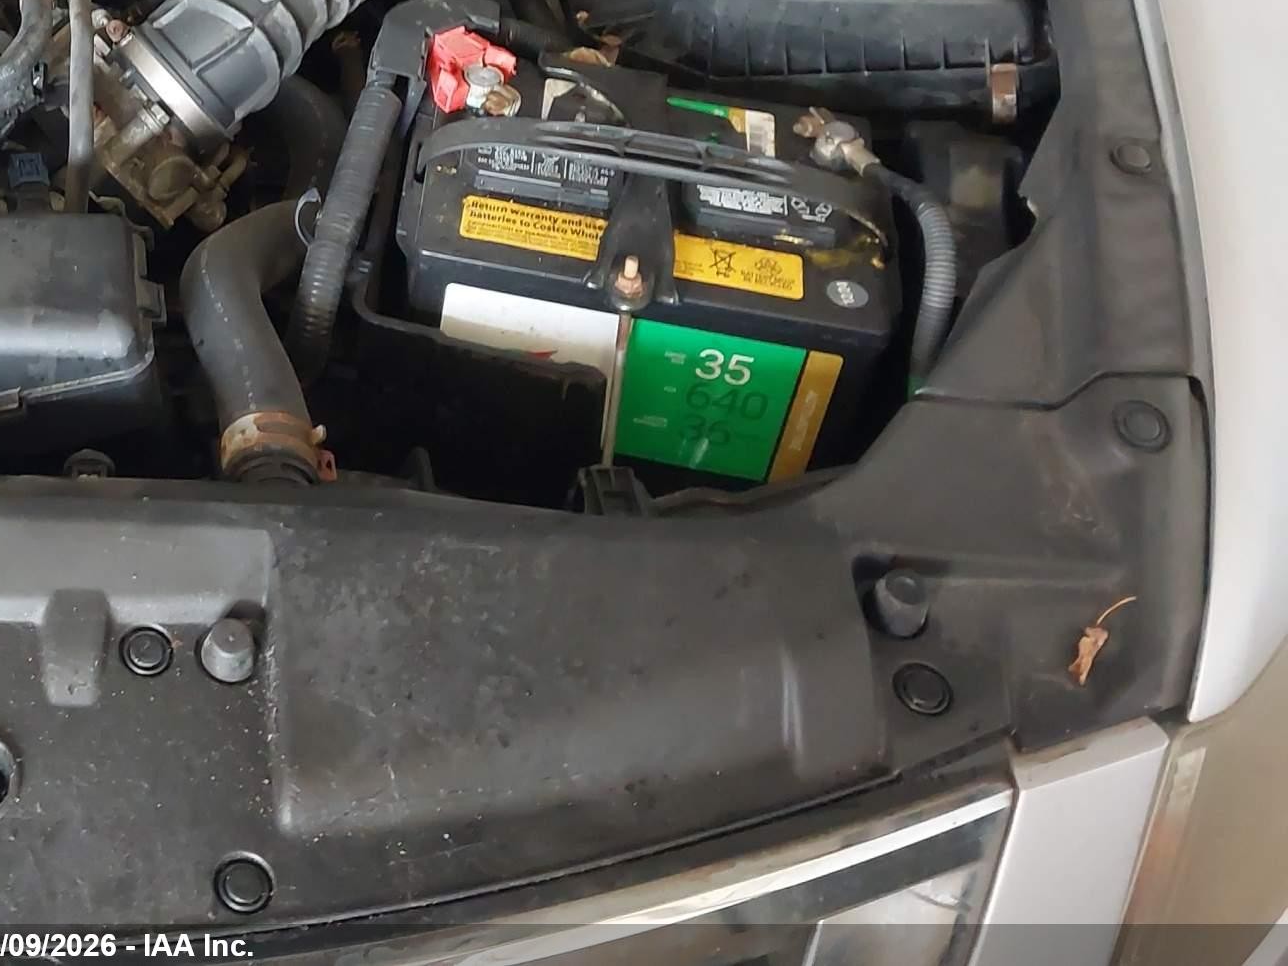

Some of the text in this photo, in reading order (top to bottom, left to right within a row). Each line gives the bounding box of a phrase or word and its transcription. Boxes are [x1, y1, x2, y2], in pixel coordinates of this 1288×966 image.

[471, 201, 604, 232] Return warranty and use
[519, 219, 531, 228] to
[533, 222, 568, 235] Costco
[570, 228, 600, 241] Whol
[695, 348, 754, 385] 35
[685, 381, 769, 421] 640
